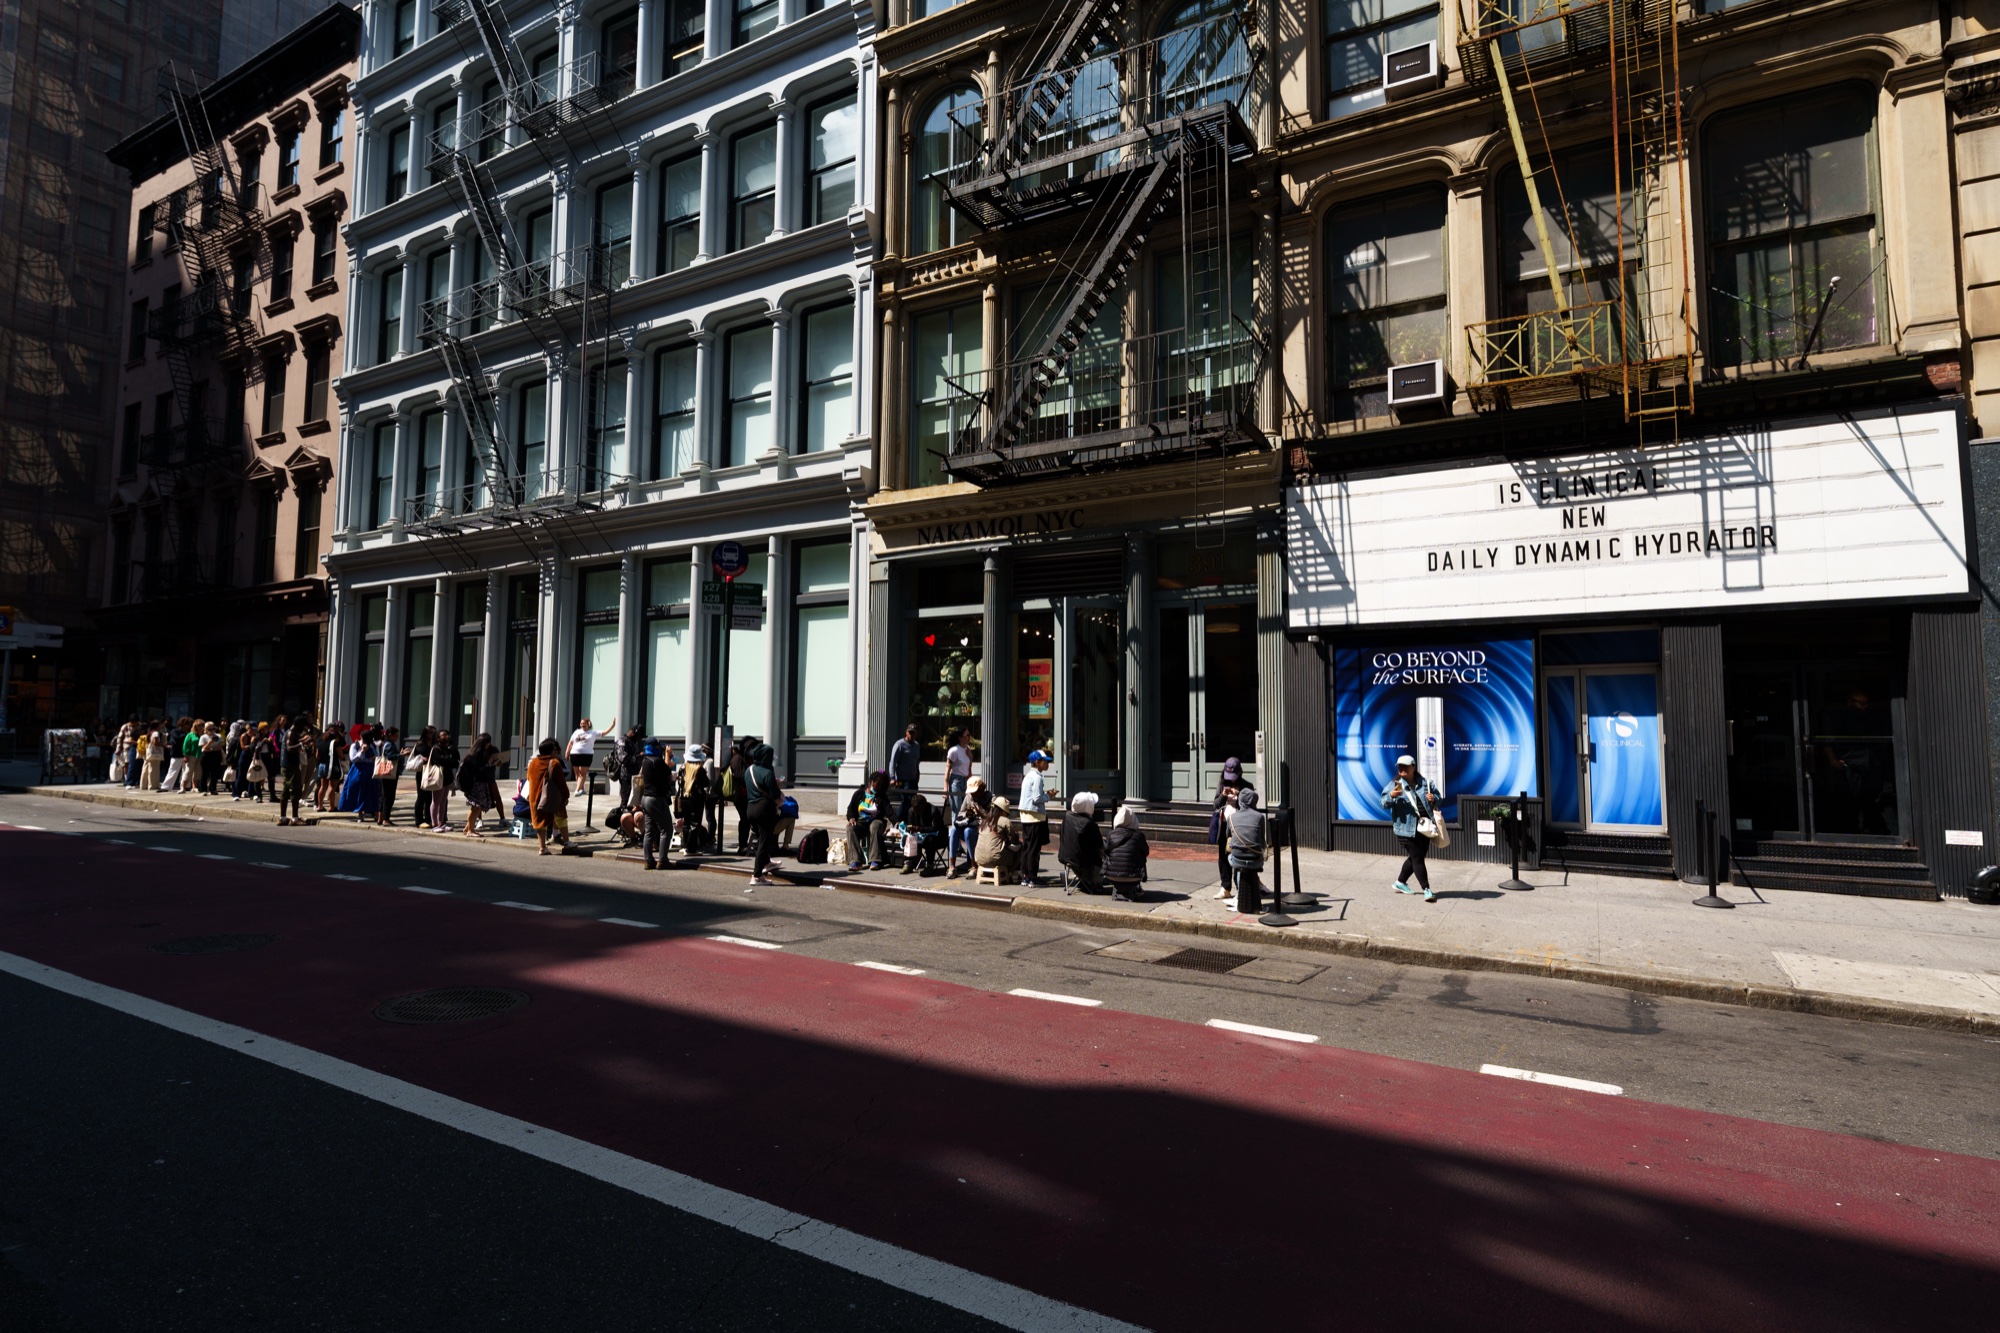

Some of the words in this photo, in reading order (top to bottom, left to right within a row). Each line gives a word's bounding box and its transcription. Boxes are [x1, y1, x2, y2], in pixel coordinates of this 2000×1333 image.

[1500, 483, 1521, 504] IS
[1540, 469, 1665, 500] CLINICAL
[1037, 509, 1084, 532] NYC
[1563, 506, 1606, 530] NEW
[1428, 547, 1498, 572] DAILY
[1515, 538, 1621, 566] DYNAMIC
[1635, 526, 1776, 556] HYDRATOR
[1190, 552, 1225, 573] 391
[704, 583, 720, 592] x27
[704, 594, 720, 603] x28
[1373, 653, 1402, 668] GO
[1407, 650, 1485, 667] BEYOND
[1372, 668, 1399, 685] the
[1402, 668, 1488, 684] SURFACE
